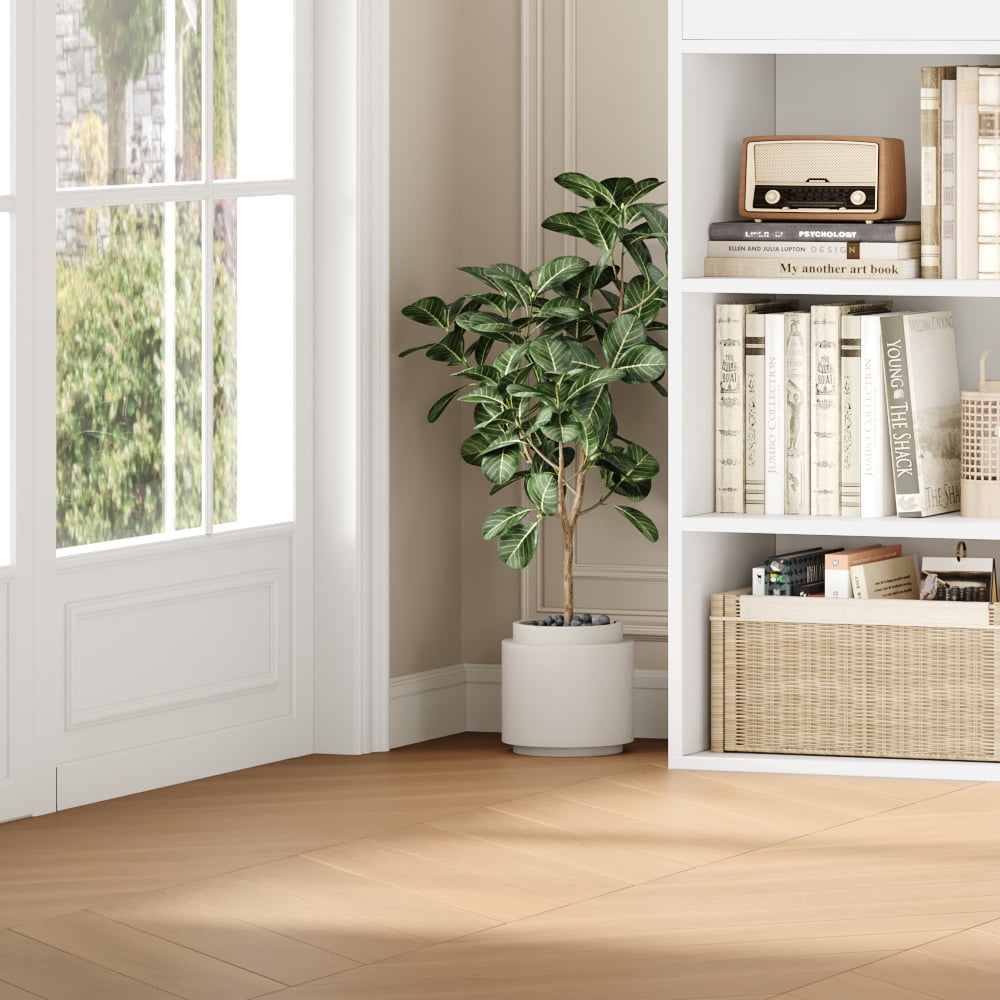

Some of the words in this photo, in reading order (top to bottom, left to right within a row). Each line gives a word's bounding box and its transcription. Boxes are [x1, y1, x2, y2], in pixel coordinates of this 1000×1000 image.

[798, 231, 857, 239] PSYCHOLOGY
[810, 246, 856, 254] DESIGN
[780, 263, 799, 276] My
[802, 264, 847, 274] another
[849, 265, 867, 275] art
[870, 264, 899, 275] book
[886, 339, 905, 389] YOUNG
[768, 357, 777, 431] COLLECTION
[863, 358, 873, 433] COLLECTION
[890, 401, 909, 430] THE
[768, 434, 779, 474] JUMBO
[863, 438, 874, 476] JUMBO
[893, 432, 913, 478] SHACK
